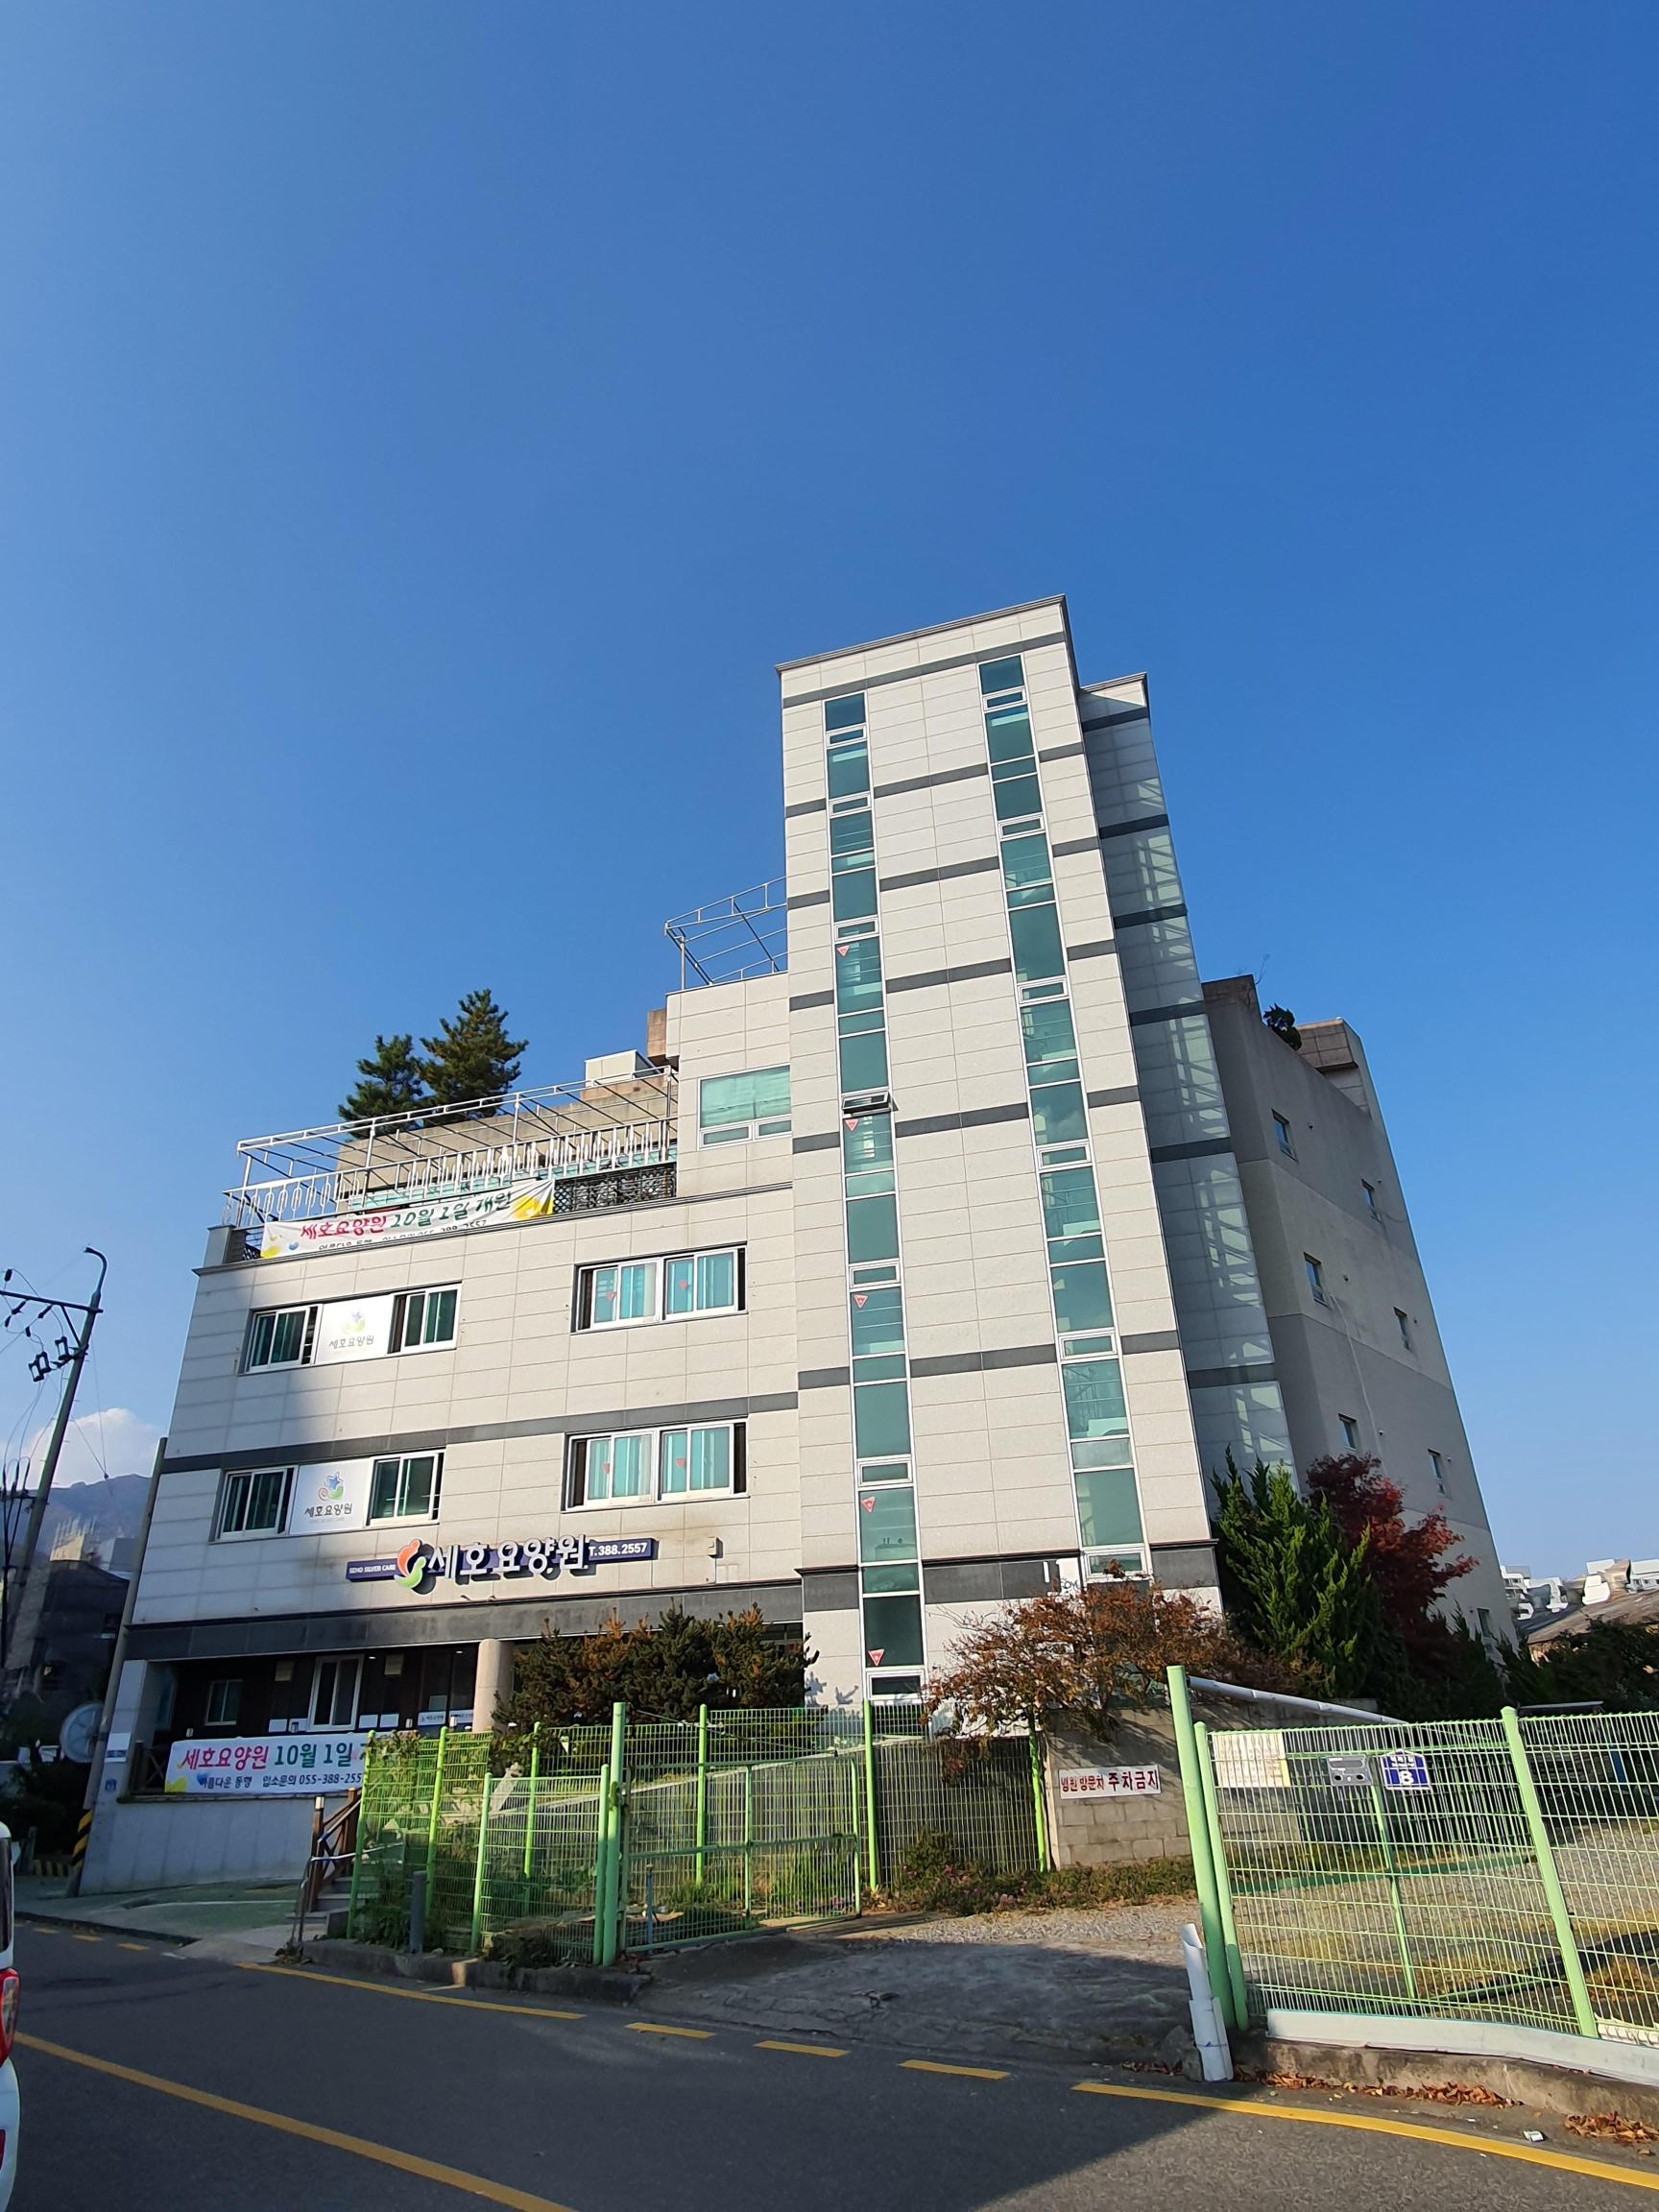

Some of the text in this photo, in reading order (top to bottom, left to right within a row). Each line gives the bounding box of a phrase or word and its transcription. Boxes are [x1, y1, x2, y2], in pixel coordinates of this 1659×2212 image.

[301, 1215, 386, 1239] 세호요양원
[391, 1209, 434, 1228] 10월
[439, 1201, 469, 1221] 1일
[474, 1191, 512, 1212] 개원
[328, 1335, 374, 1349] 세호요양원
[303, 1503, 353, 1518] 세호요양원
[427, 1534, 586, 1578] 세호요양원
[589, 1542, 648, 1556] T.388.2557
[181, 1745, 269, 1770] 세호요양원
[274, 1743, 317, 1767] 10월
[323, 1743, 352, 1767] 1일
[262, 1774, 297, 1788] 입소문의
[299, 1773, 362, 1785] 055-388-255
[1108, 1769, 1159, 1791] 주차금지
